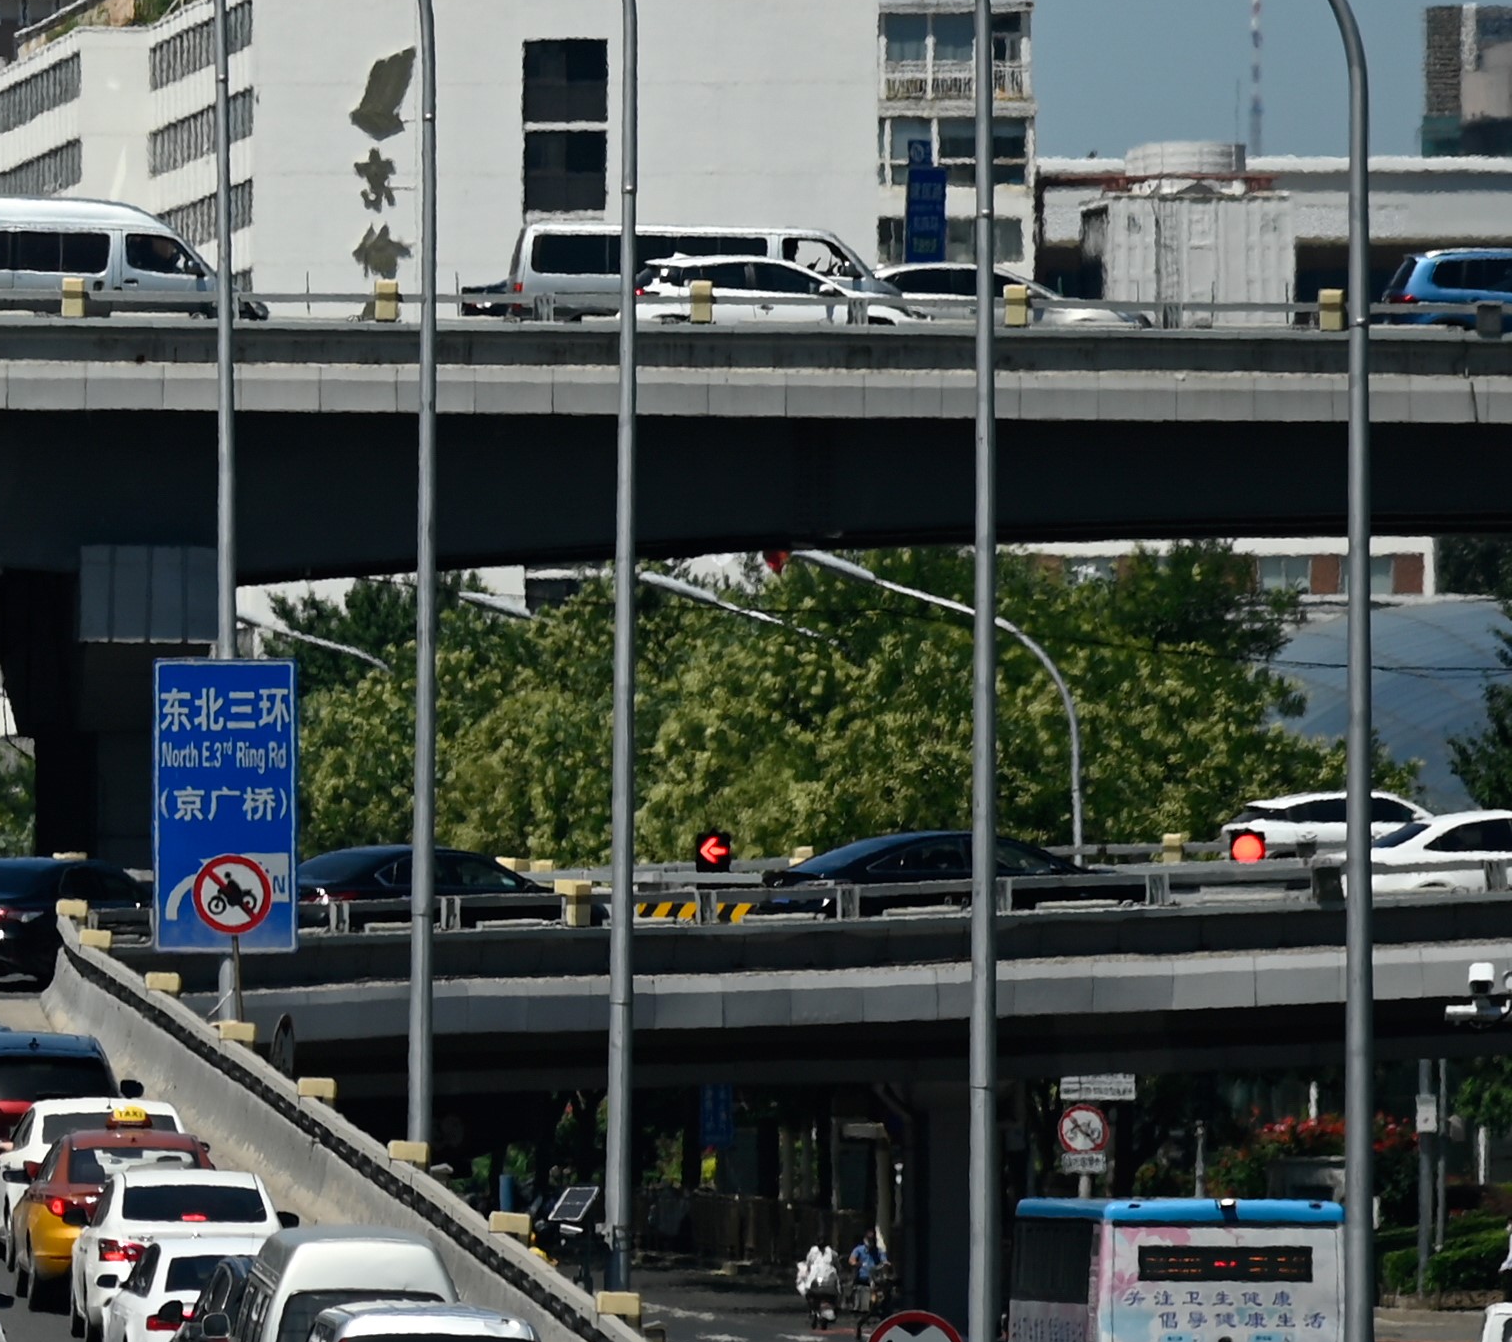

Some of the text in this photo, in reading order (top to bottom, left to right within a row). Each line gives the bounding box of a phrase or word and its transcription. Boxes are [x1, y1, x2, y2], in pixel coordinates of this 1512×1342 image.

[160, 687, 289, 732] 东北三环
[161, 741, 198, 768] North
[236, 741, 265, 774] Ring
[268, 741, 286, 768] Rd
[160, 785, 287, 822] (京广桥)
[119, 1110, 144, 1118] TAXI
[1123, 1290, 1293, 1308] 关注卫生健康
[1158, 1312, 1327, 1329] 倡导健康生活
